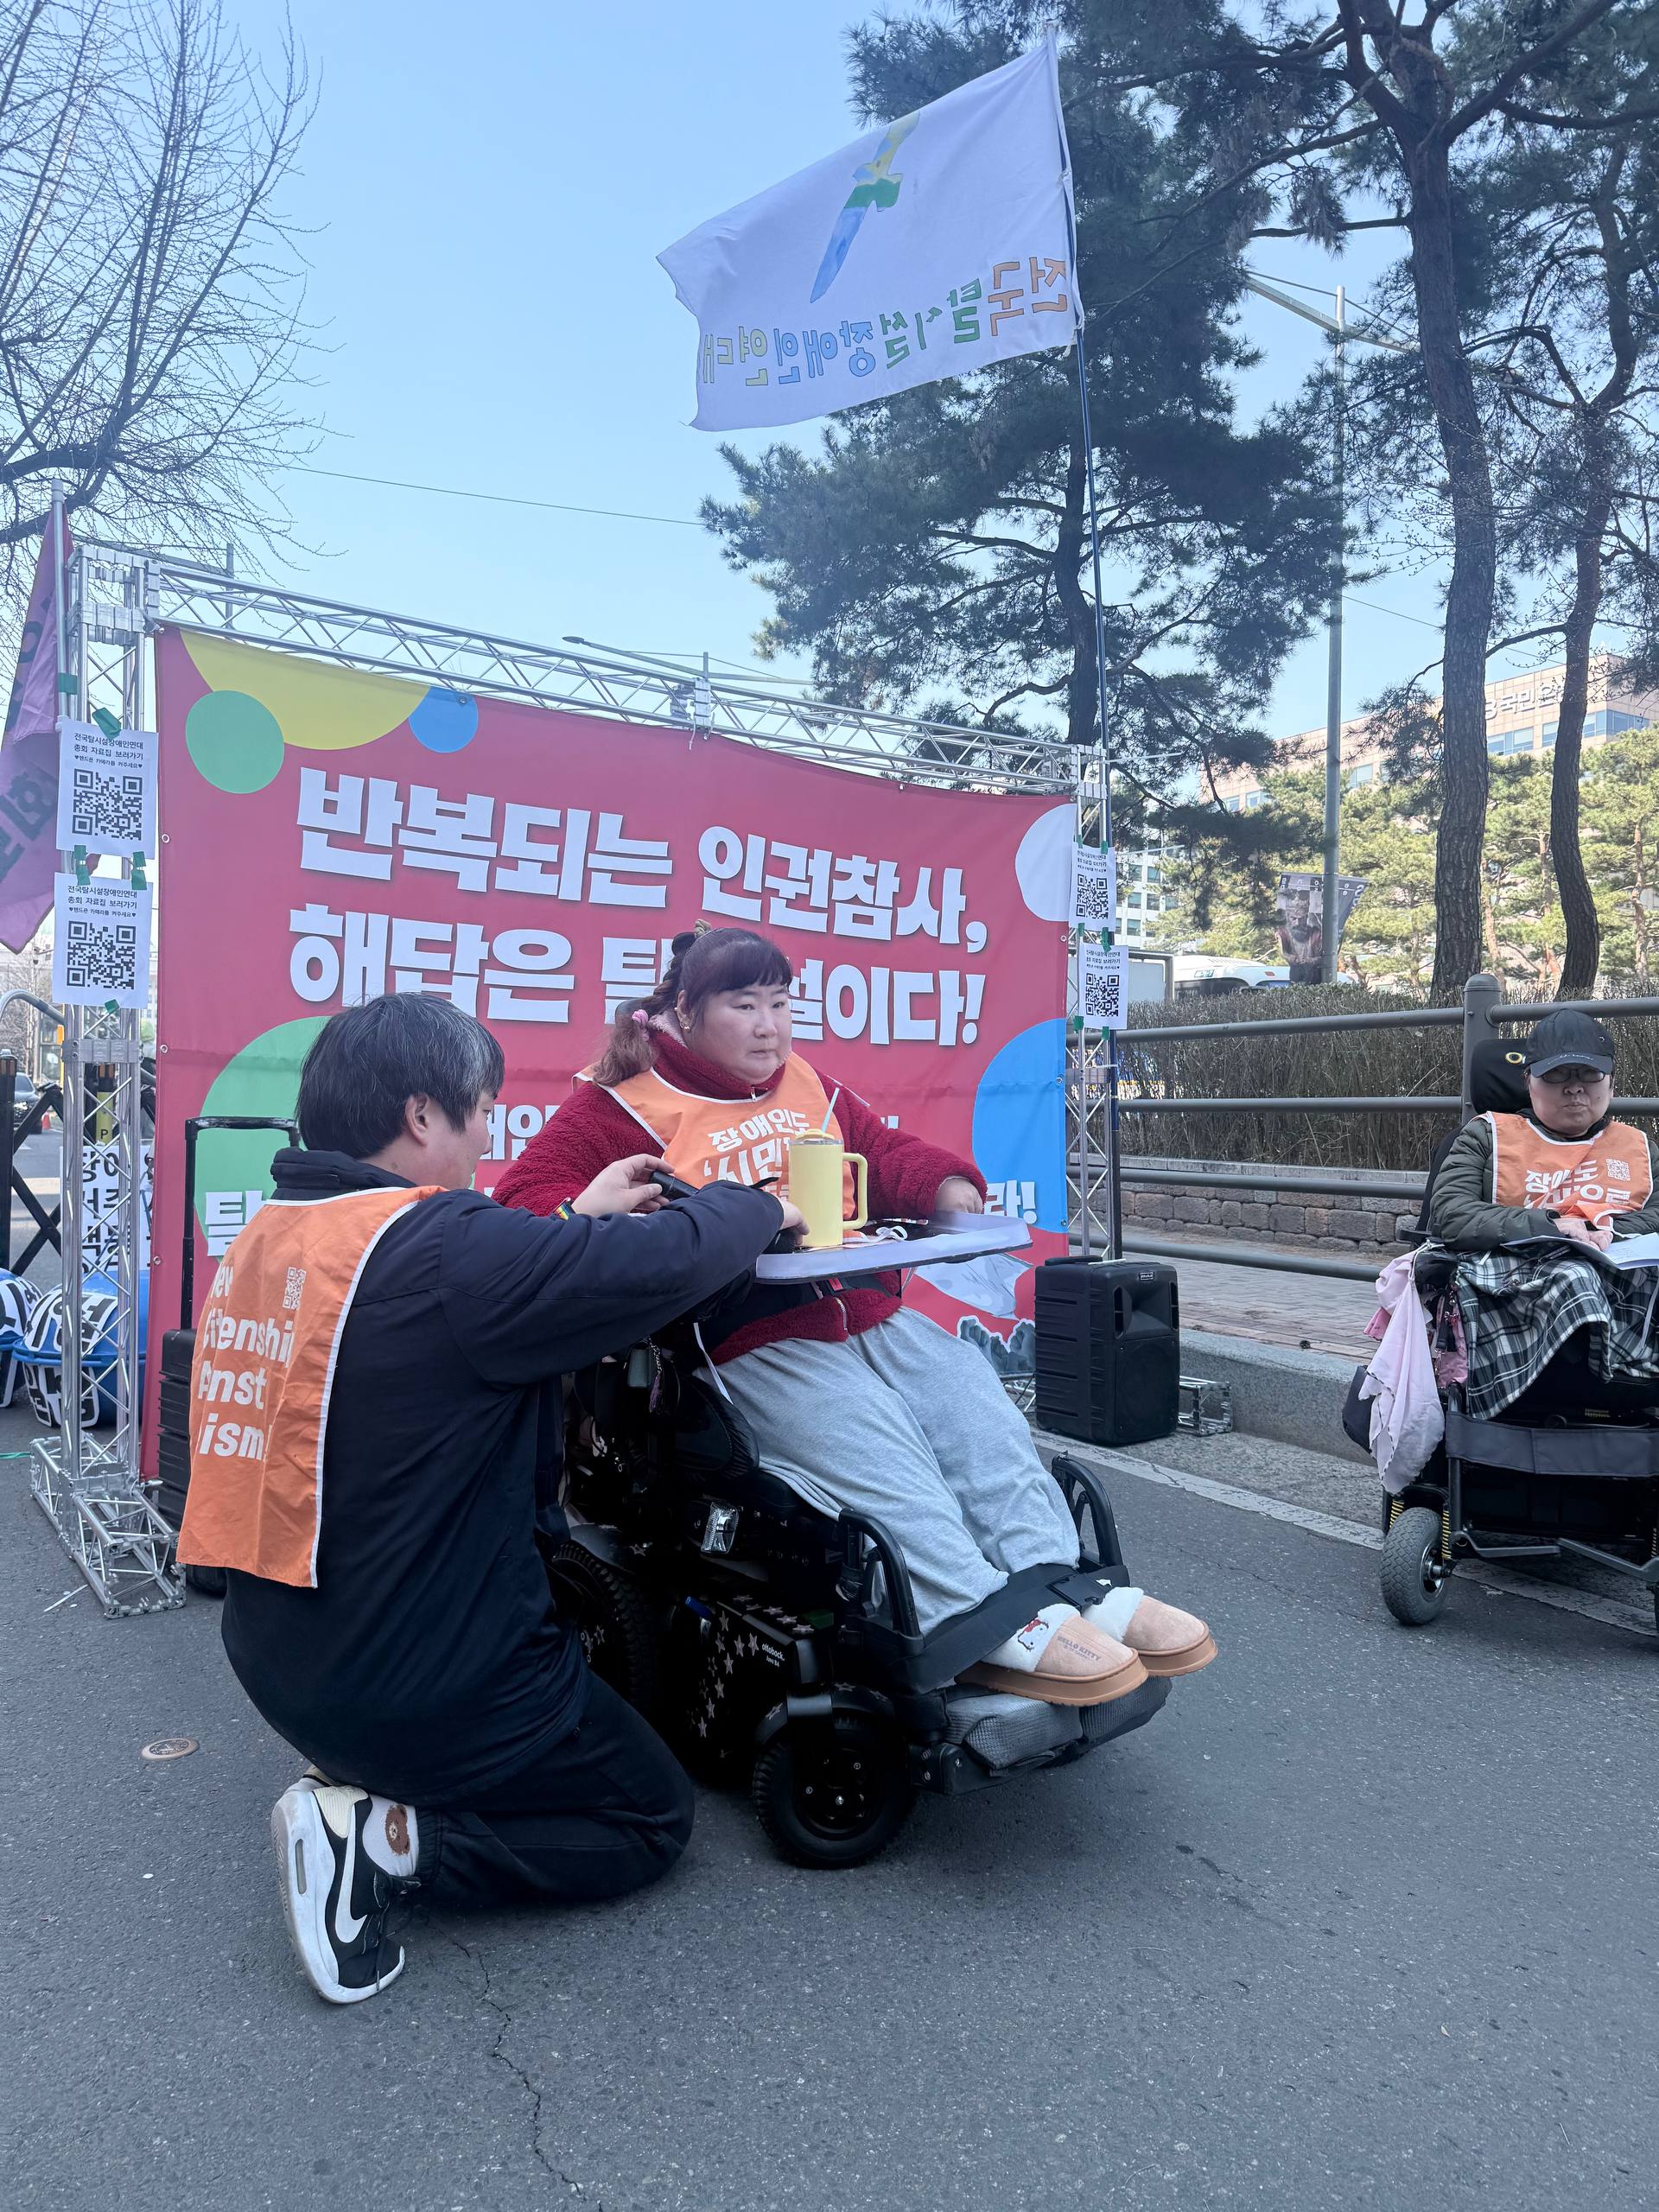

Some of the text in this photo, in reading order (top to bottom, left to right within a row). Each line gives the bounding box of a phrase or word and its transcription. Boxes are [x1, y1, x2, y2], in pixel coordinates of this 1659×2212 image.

[74, 733, 143, 750] 전국탈시설장애인연대
[74, 744, 143, 760] 총회 자료집 보러가기
[296, 766, 988, 956] 반복되는 인권참사,
[67, 885, 137, 899] 전국탈시설장애인연대
[86, 898, 106, 906] 자료집
[109, 900, 137, 909] 보러가기
[289, 902, 986, 1047] 해답은 탈설이다!
[707, 1109, 810, 1152] 장애인도
